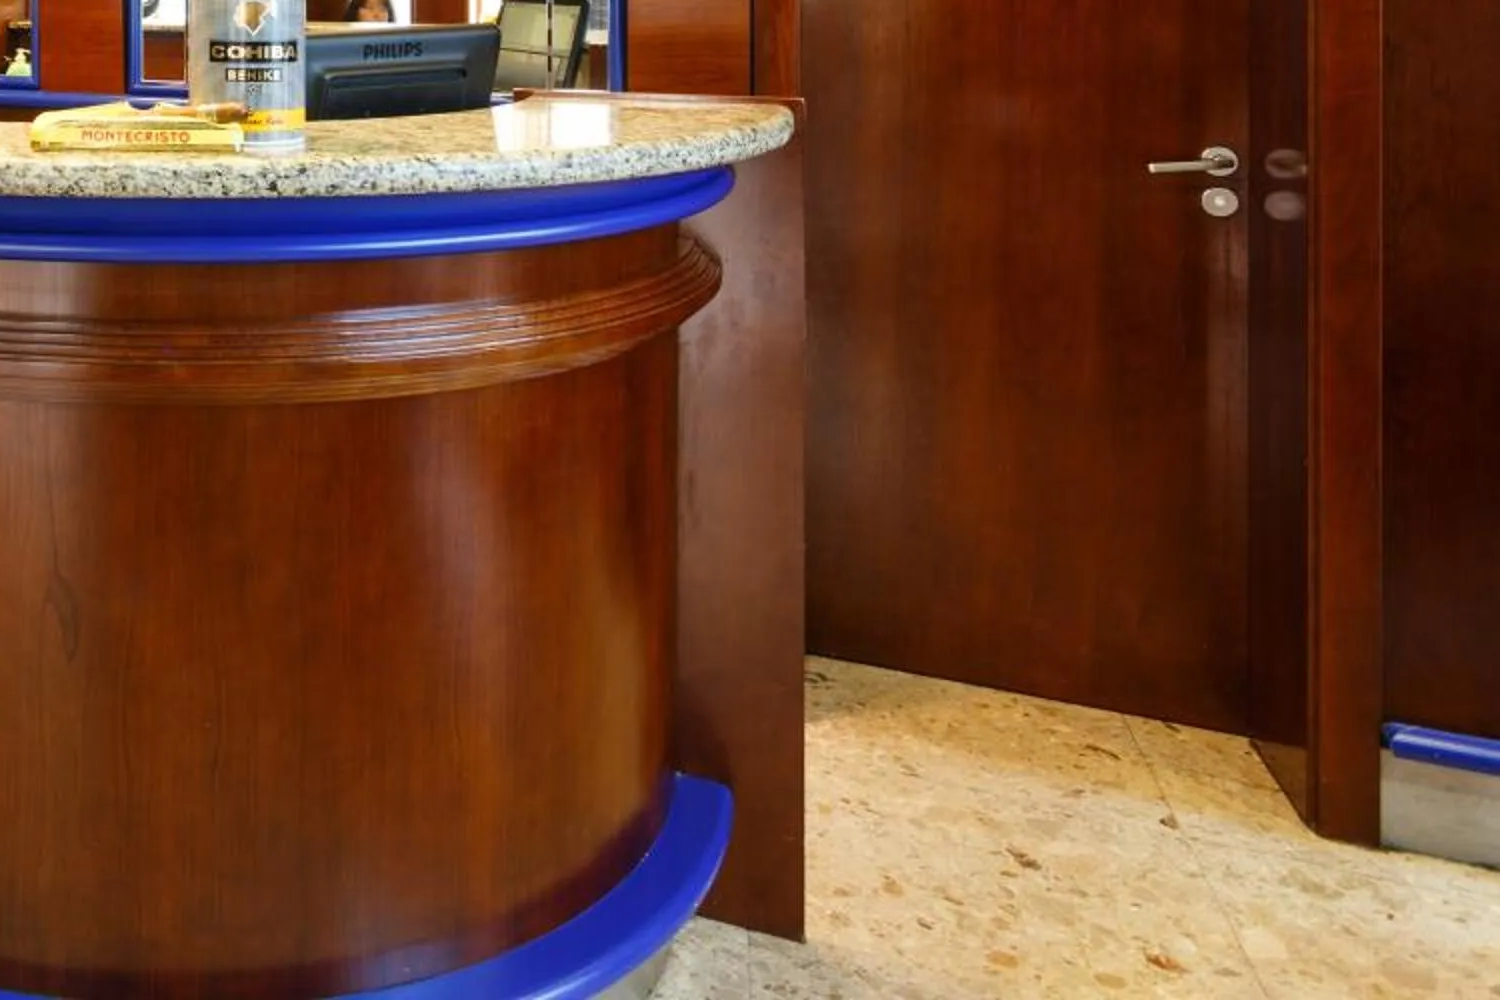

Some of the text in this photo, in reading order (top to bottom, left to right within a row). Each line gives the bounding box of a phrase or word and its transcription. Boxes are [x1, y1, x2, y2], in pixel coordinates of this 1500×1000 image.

[211, 45, 296, 59] COHIBA
[362, 42, 424, 61] PHILIPS
[81, 130, 190, 143] MONTECRISTO
